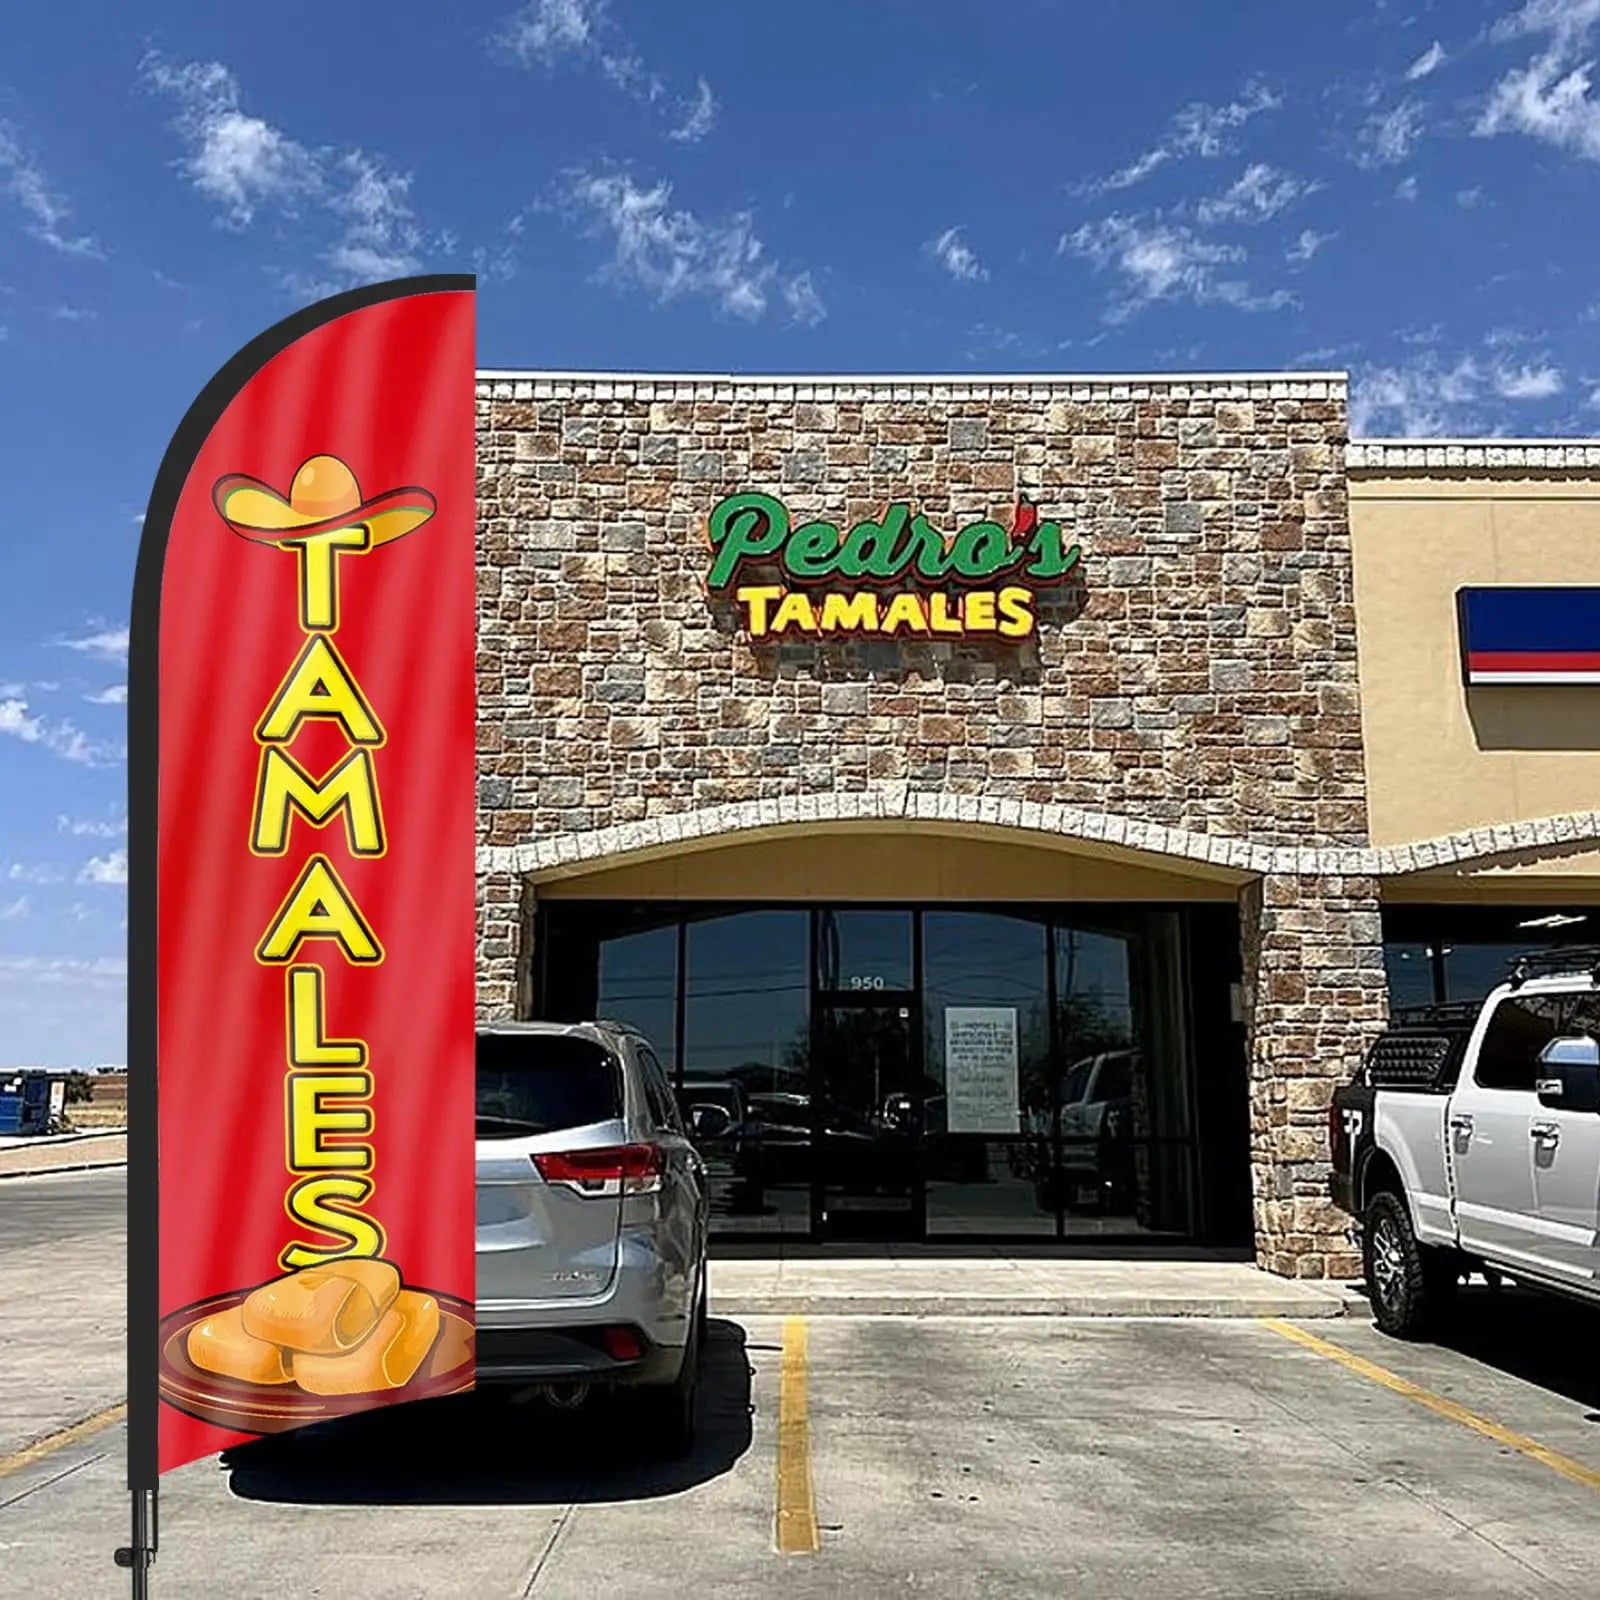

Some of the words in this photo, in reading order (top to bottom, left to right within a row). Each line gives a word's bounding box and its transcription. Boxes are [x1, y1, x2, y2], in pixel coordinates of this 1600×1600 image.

[707, 493, 1080, 588] Pedro's
[737, 586, 1034, 638] TAMALES
[250, 523, 387, 1272] TAMALES
[851, 976, 884, 990] 950
